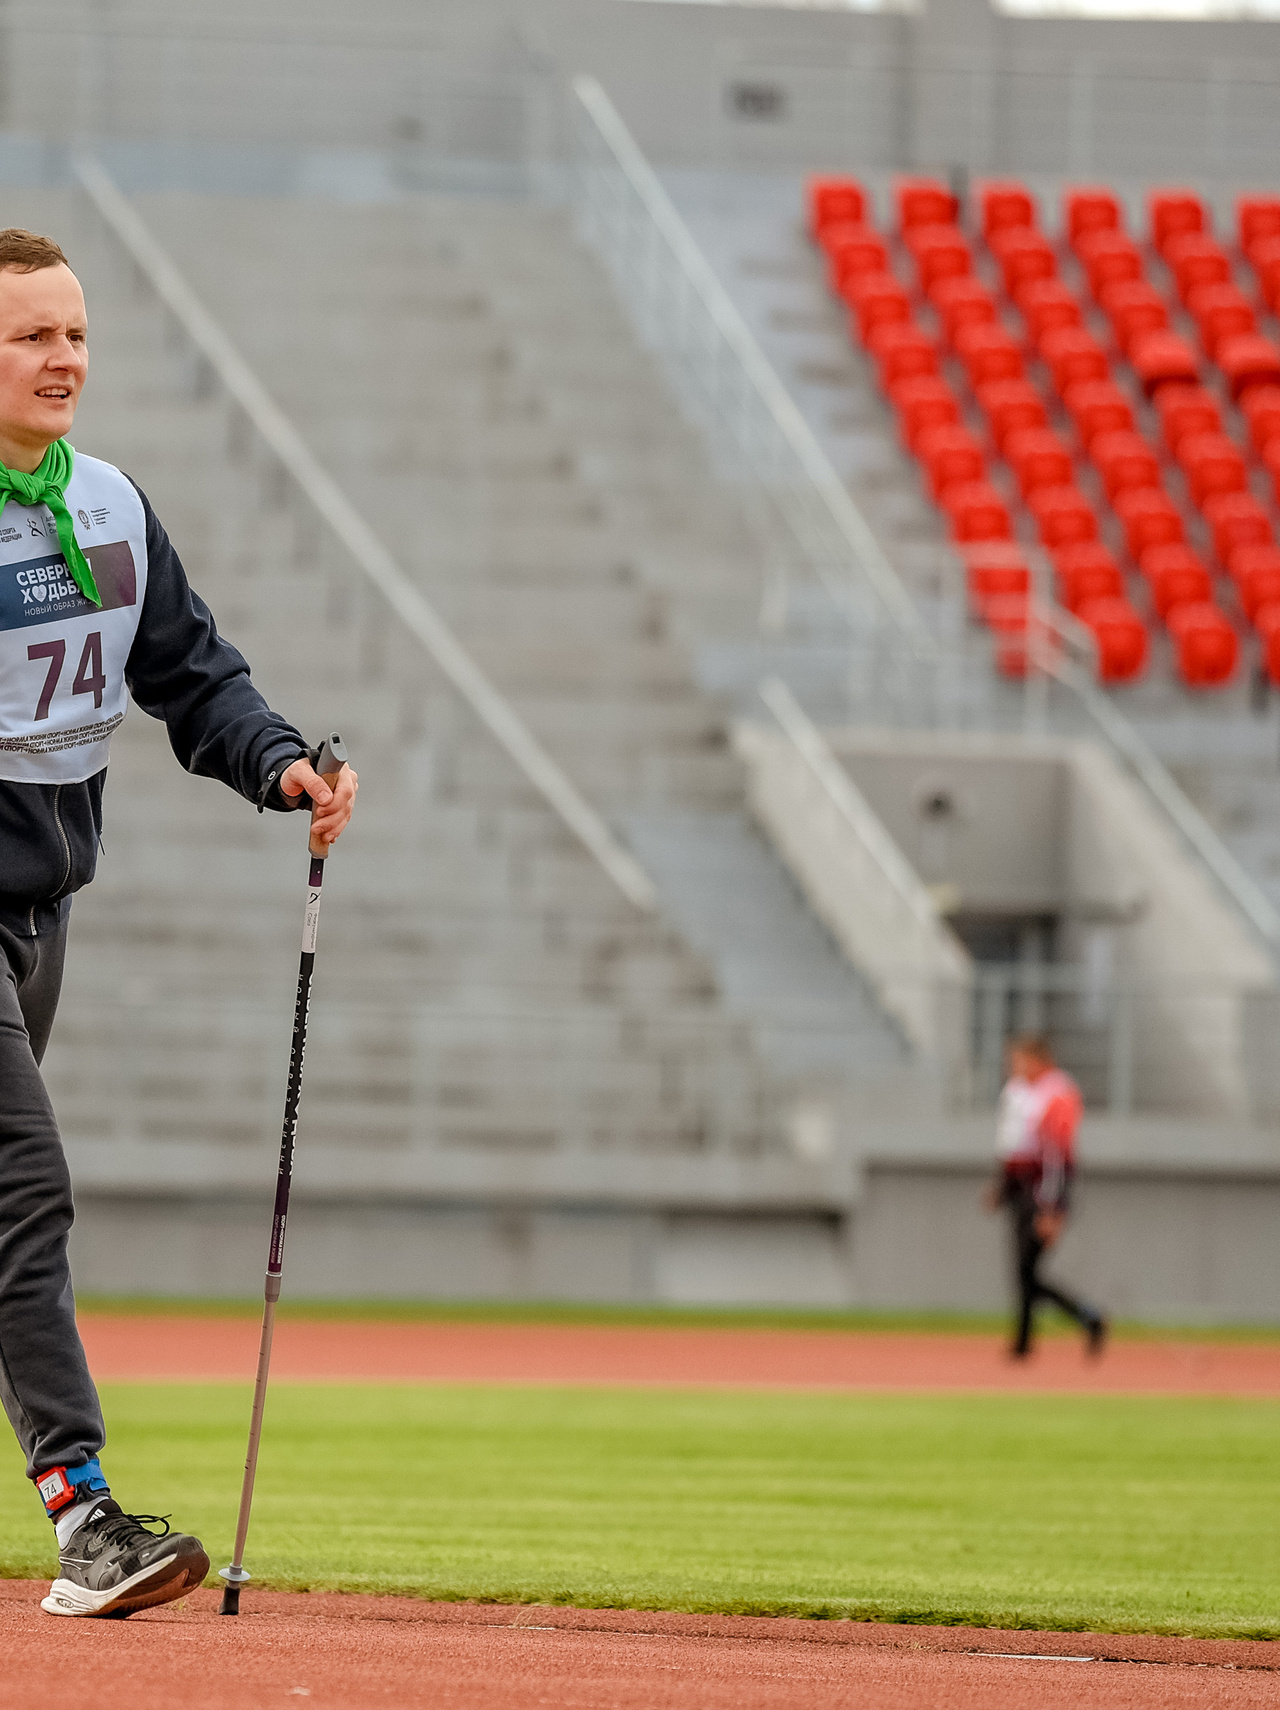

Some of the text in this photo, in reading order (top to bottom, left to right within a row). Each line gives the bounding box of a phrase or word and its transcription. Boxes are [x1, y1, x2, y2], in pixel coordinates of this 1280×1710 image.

[16, 558, 92, 586] СЕВЕРН
[24, 604, 52, 616] НОВЫЙ
[53, 600, 75, 611] ОБРАЗ
[27, 631, 106, 721] 74
[45, 1483, 57, 1498] 74
